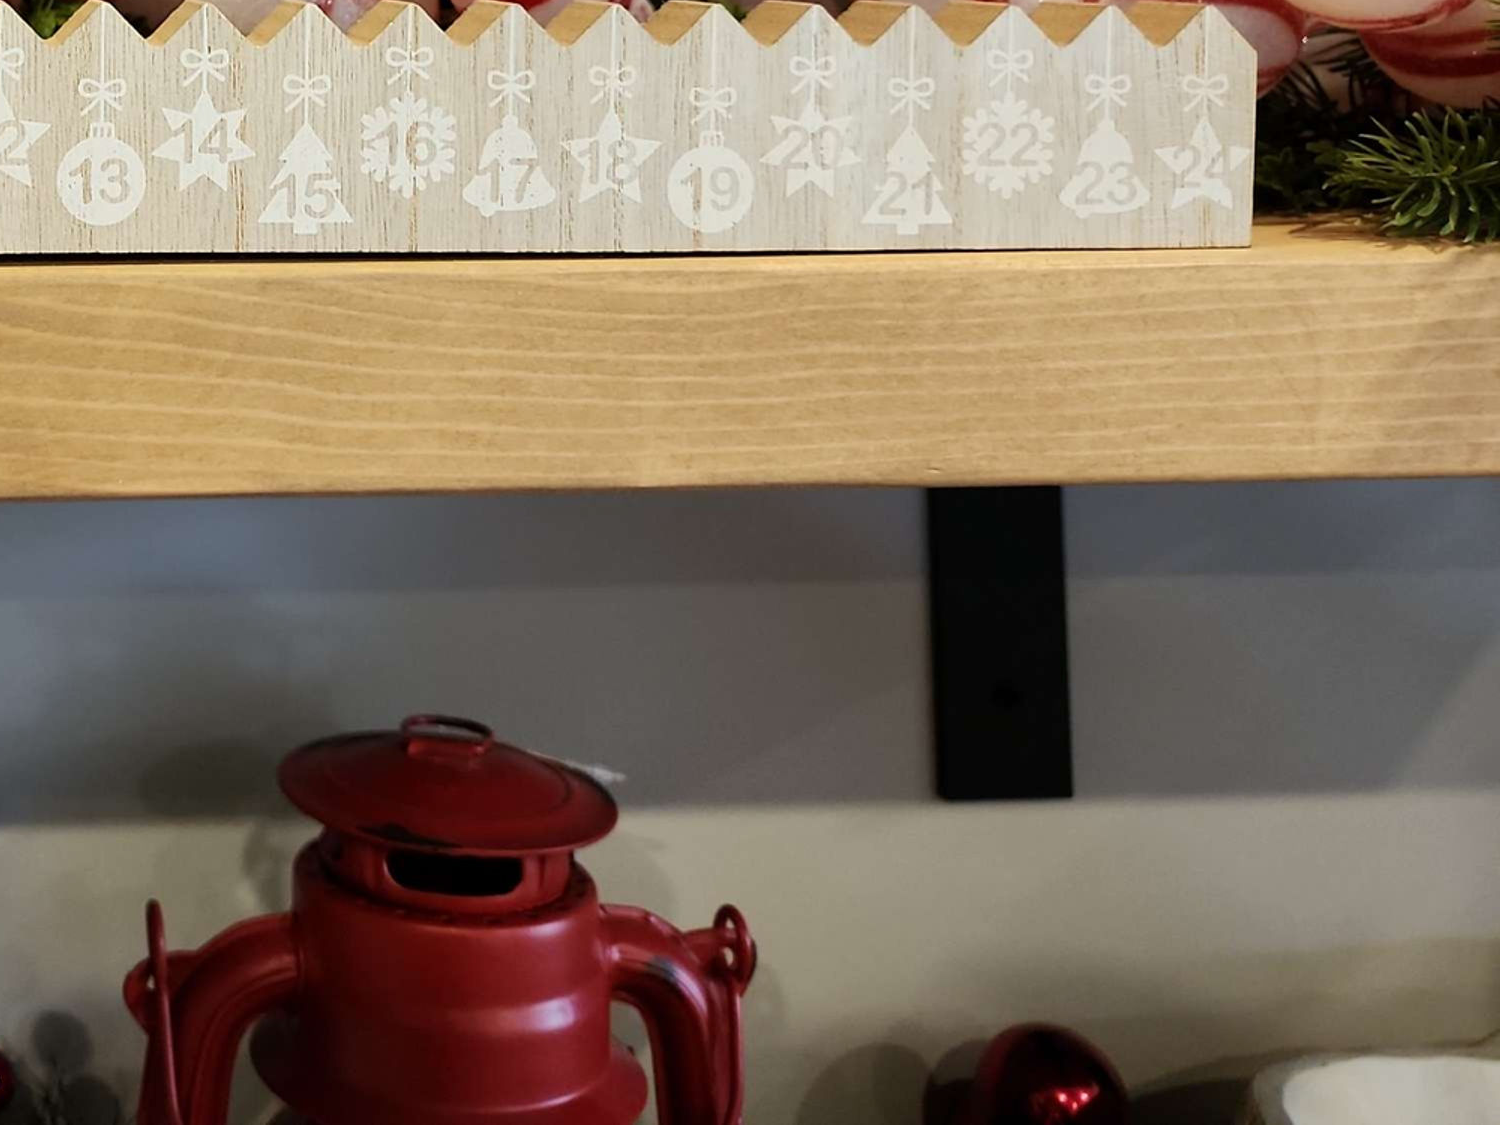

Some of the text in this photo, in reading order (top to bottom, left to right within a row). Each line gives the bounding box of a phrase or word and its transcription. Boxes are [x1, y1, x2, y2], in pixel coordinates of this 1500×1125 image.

[67, 157, 132, 205] 13
[174, 118, 234, 165] 14
[276, 172, 336, 220] 15
[374, 118, 438, 166] 16
[476, 159, 536, 205] 17
[578, 138, 638, 184] 18
[680, 164, 742, 212] 19
[776, 123, 844, 172] 20
[877, 171, 935, 217] 21
[975, 120, 1038, 168] 22
[1074, 159, 1137, 207] 23
